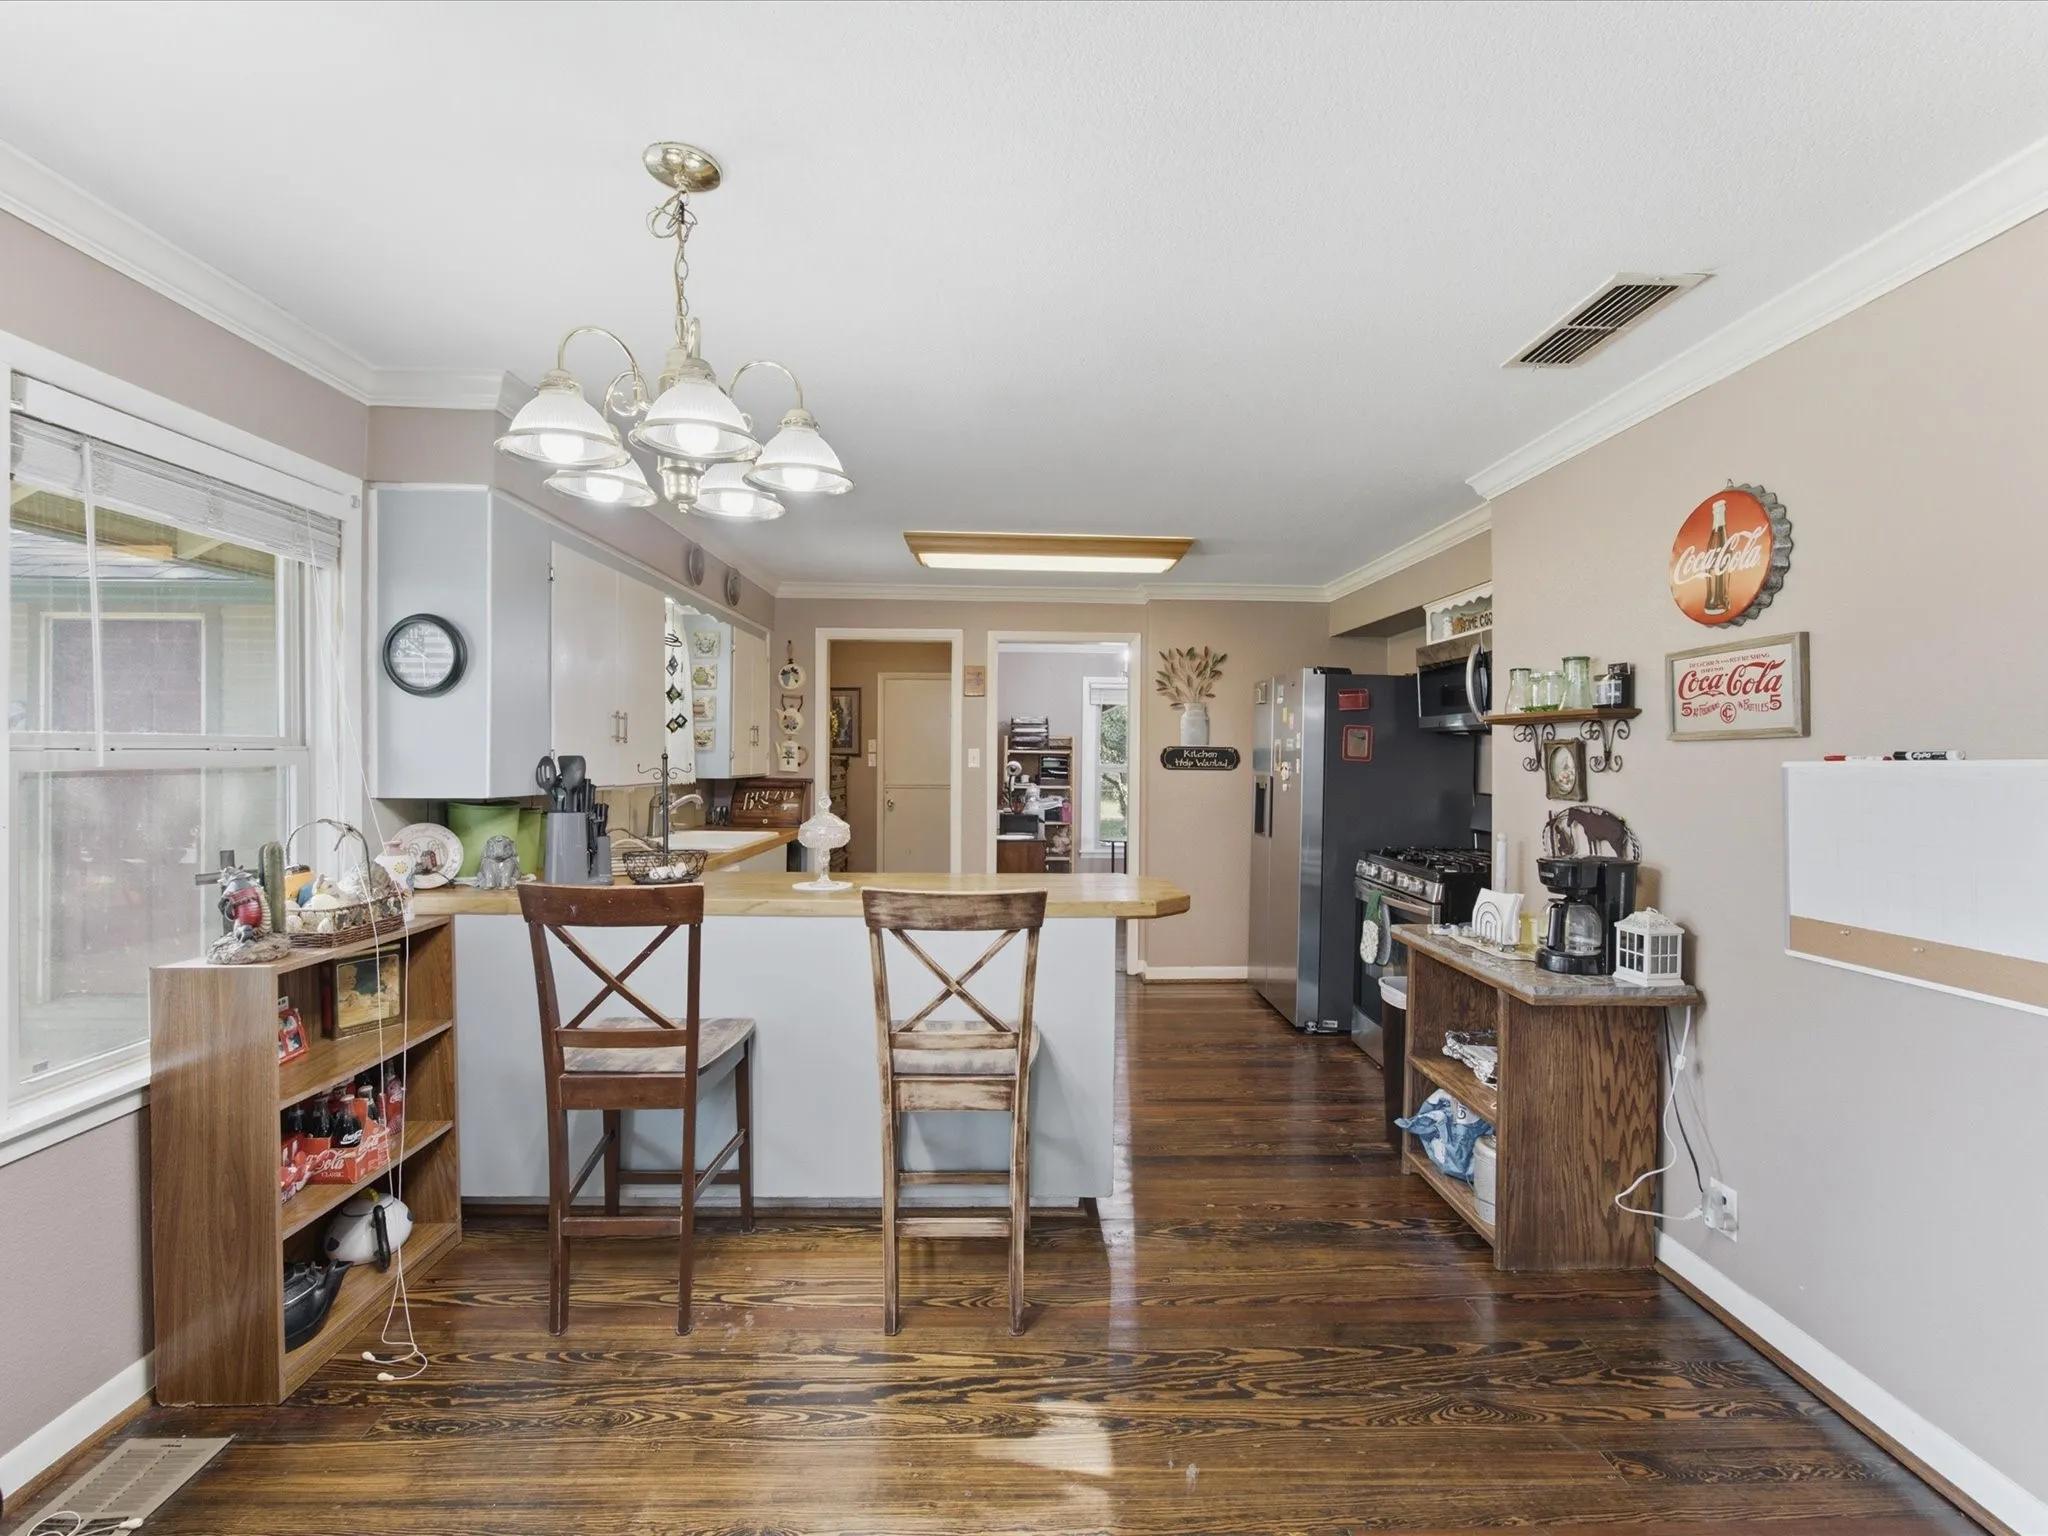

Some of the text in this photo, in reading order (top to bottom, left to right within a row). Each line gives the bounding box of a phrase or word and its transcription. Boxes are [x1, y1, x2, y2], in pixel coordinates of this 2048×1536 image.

[1673, 523, 1769, 585] Coca-Cola
[1678, 659, 1786, 700] Coca-Cola
[1183, 749, 1218, 758] Kitchen
[1195, 758, 1228, 768] Wanted
